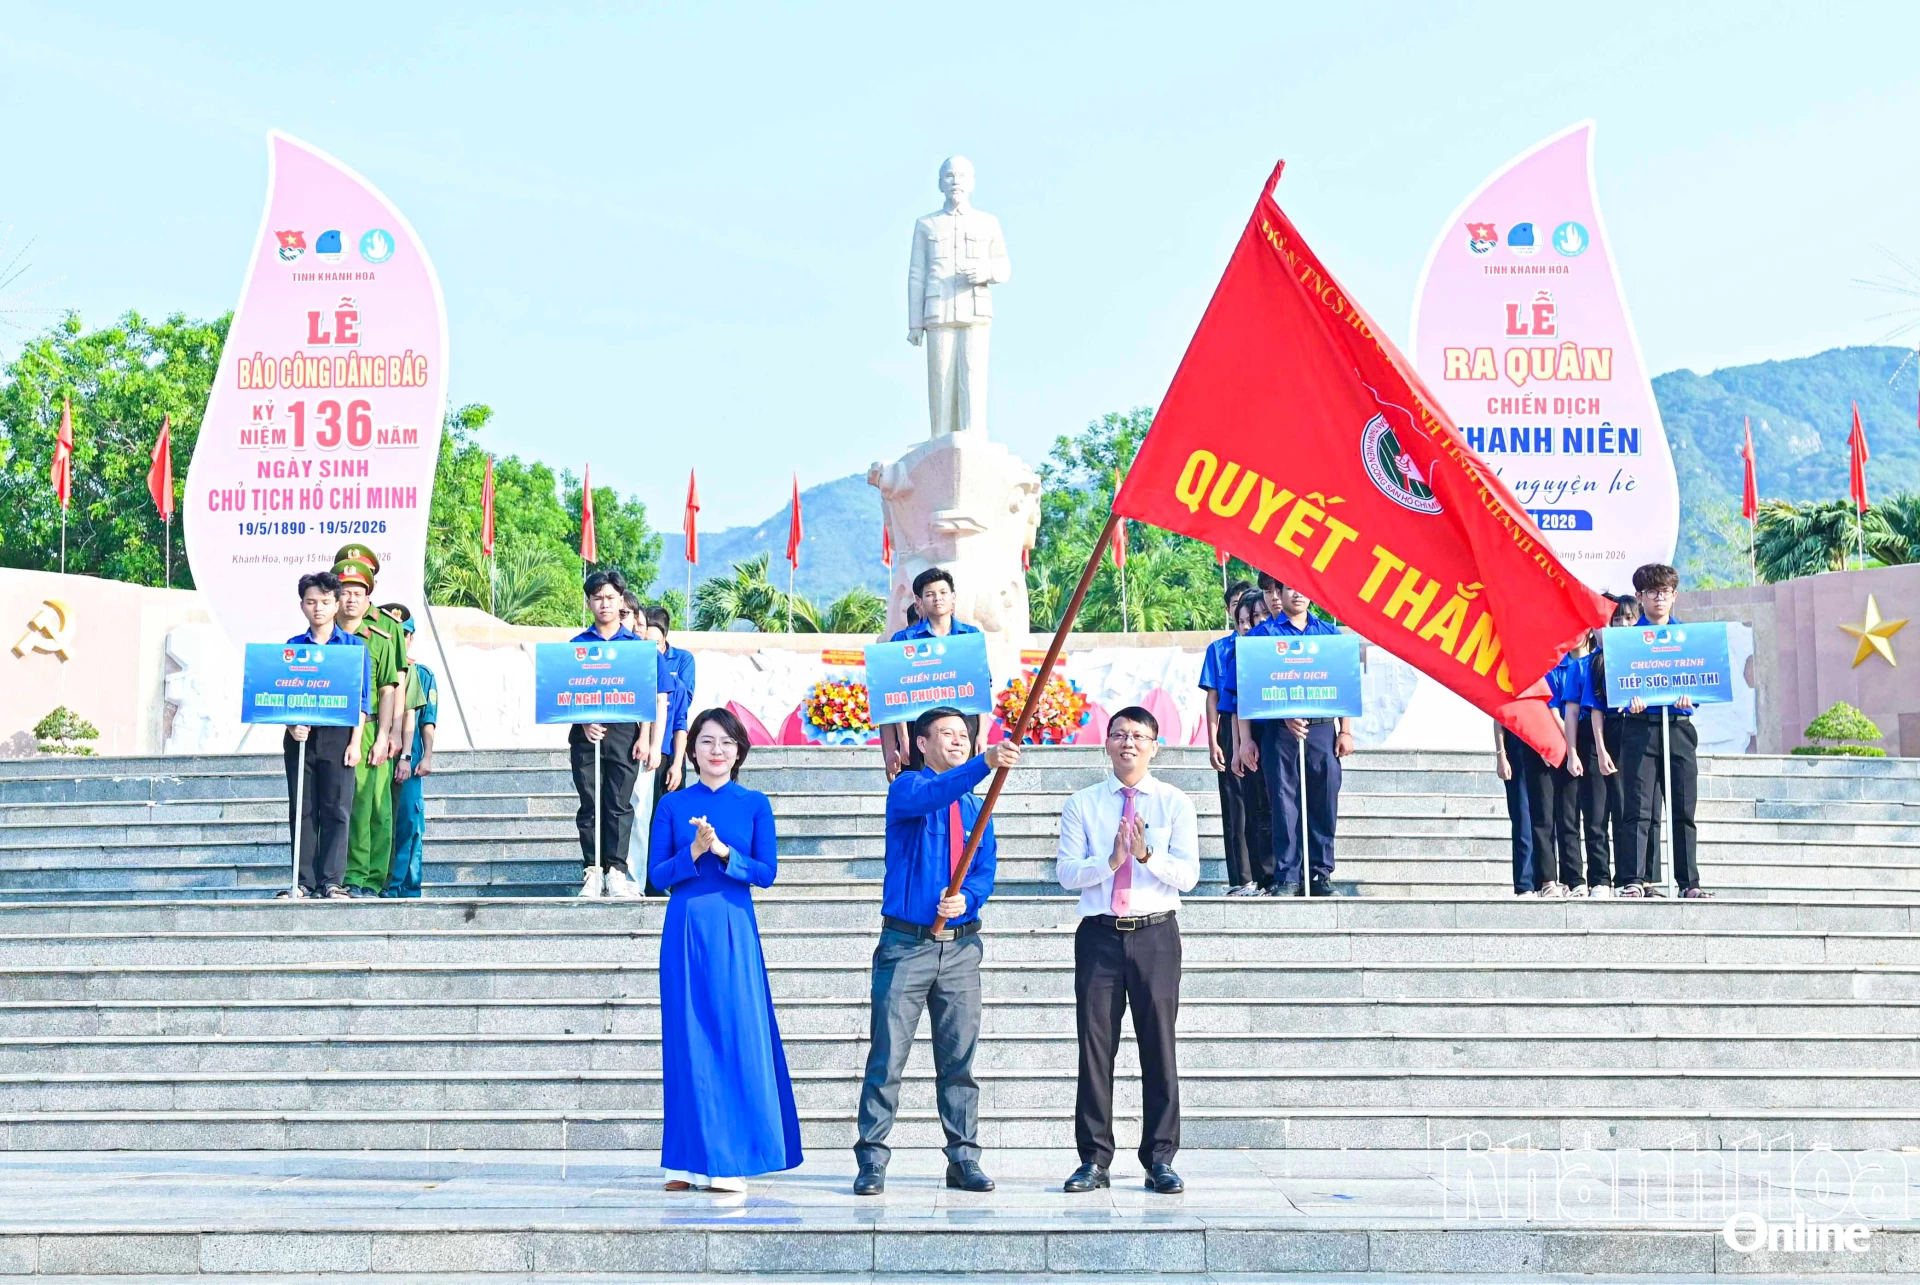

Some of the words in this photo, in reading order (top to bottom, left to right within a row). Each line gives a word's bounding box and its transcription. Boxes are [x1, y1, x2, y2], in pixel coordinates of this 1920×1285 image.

[1300, 263, 1349, 315] TNCS
[307, 297, 359, 345] LỄ
[1506, 290, 1555, 336] LỄ
[238, 352, 277, 389] BÁO
[279, 351, 331, 389] CÔNG
[334, 350, 385, 388] DÂNG
[389, 350, 427, 387] BÁC
[1444, 347, 1498, 381] RA
[1505, 341, 1612, 387] QUÂN
[253, 400, 274, 421] KỶ
[1487, 391, 1547, 415] CHIẾN
[1553, 397, 1600, 419] DỊCH
[240, 425, 286, 449] NIỆM
[288, 399, 372, 448] 136
[377, 425, 418, 445] NĂM
[1563, 422, 1639, 454] NIÊN
[257, 457, 313, 479] NGÀY
[319, 459, 369, 478] SINH
[1515, 475, 1599, 505] nguyện
[1608, 468, 1638, 495] hè
[208, 482, 245, 512] CHỦ
[252, 488, 293, 516] TỊCH
[299, 479, 324, 510] HỒ
[330, 483, 361, 509] CHÍ
[367, 487, 417, 509] MINH
[1175, 449, 1359, 573] QUYẾT
[1542, 514, 1576, 529] 2026
[238, 522, 306, 536] 19/5/1890
[319, 520, 387, 535] 19/5/2026
[306, 553, 316, 563] 15
[1578, 550, 1583, 560] 5
[1605, 550, 1626, 560] 2026
[1630, 659, 1671, 669] CHƯƠNG
[1674, 657, 1705, 667] TRÌNH
[275, 678, 304, 688] CHIẾN
[307, 680, 330, 689] DỊCH
[568, 675, 598, 685] CHIẾN
[601, 676, 625, 686] DỊCH
[900, 672, 930, 684] CHIẾN
[932, 670, 956, 682] DỊCH
[1270, 670, 1300, 680] CHIẾN
[1303, 671, 1328, 681] DỊCH
[1618, 673, 1642, 689] TIẾP
[1646, 673, 1669, 688] SỨC
[1672, 672, 1697, 687] MÙA
[1699, 671, 1720, 686] THI
[255, 692, 285, 707] HÀNH
[287, 693, 316, 708] QUÂN
[318, 695, 348, 709] XANH
[604, 688, 635, 705] HỒNG
[885, 691, 908, 706] HOA
[910, 684, 956, 704] PHƯỢNG
[1262, 686, 1288, 701] MÙA
[1289, 685, 1305, 700] HÈ
[1306, 686, 1337, 700] XANH
